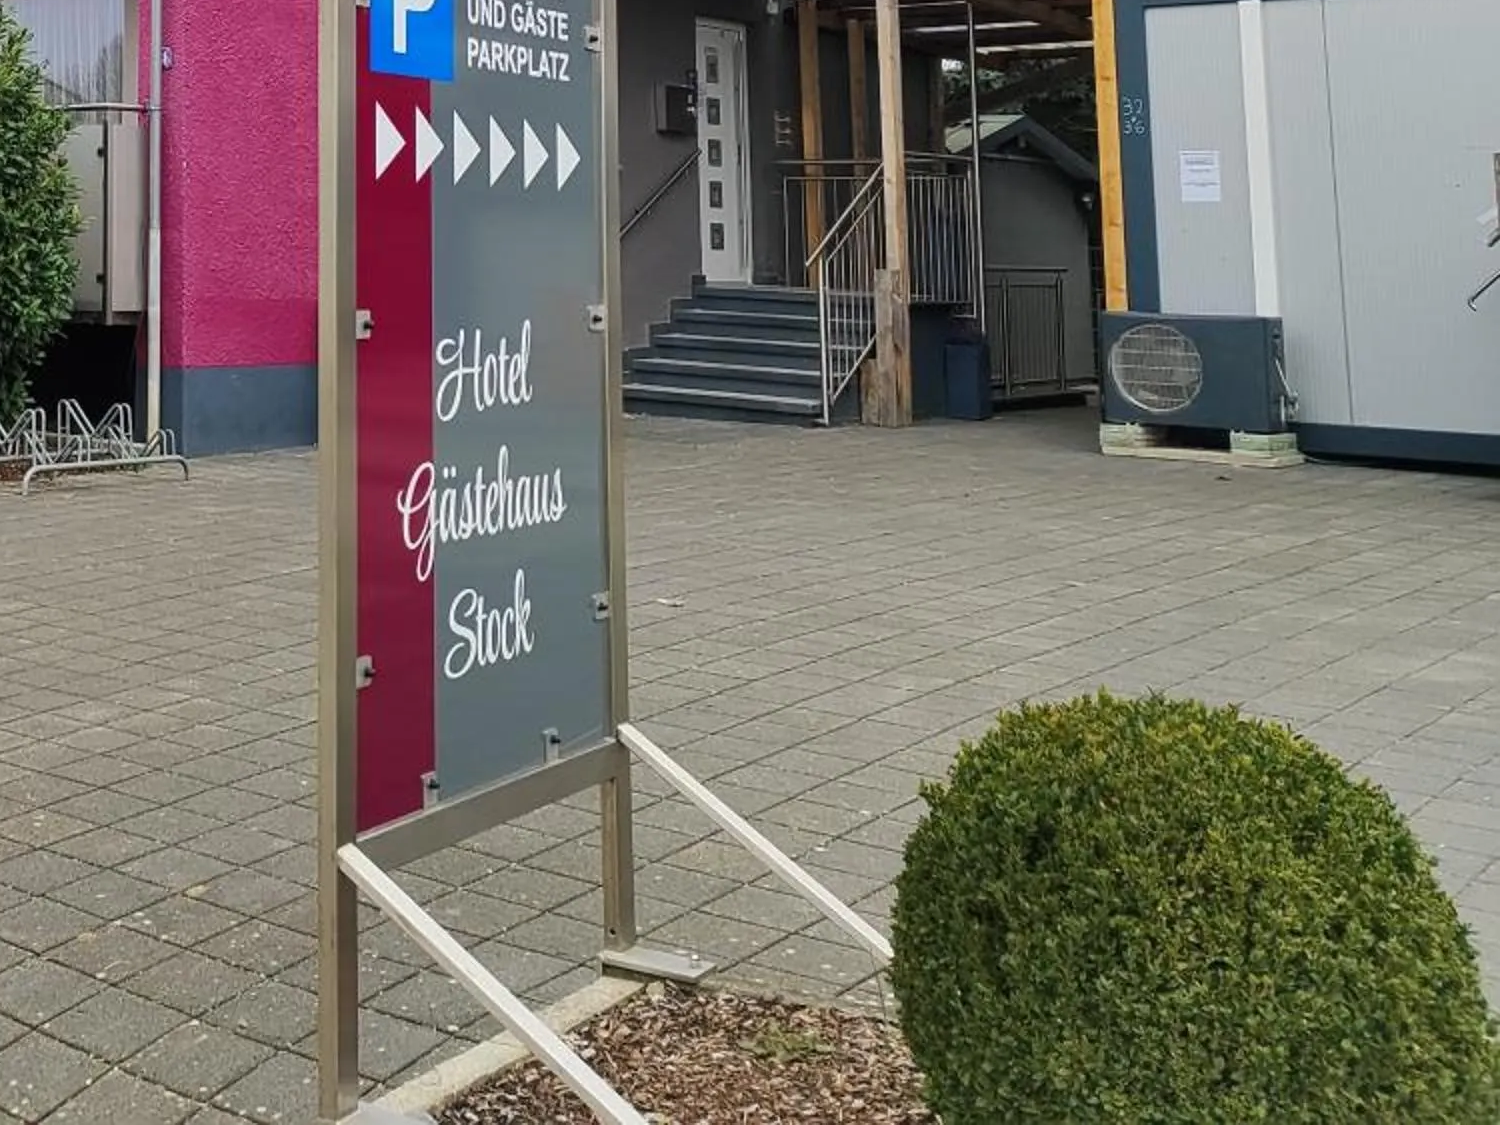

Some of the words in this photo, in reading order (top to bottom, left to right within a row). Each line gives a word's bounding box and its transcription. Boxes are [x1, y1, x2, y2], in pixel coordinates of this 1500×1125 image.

[466, 37, 571, 82] PARKPLATZ
[510, 0, 569, 42] GÄSTE
[435, 318, 533, 422] Hotel
[396, 444, 568, 582] Gästehaus
[443, 568, 535, 679] Stock
